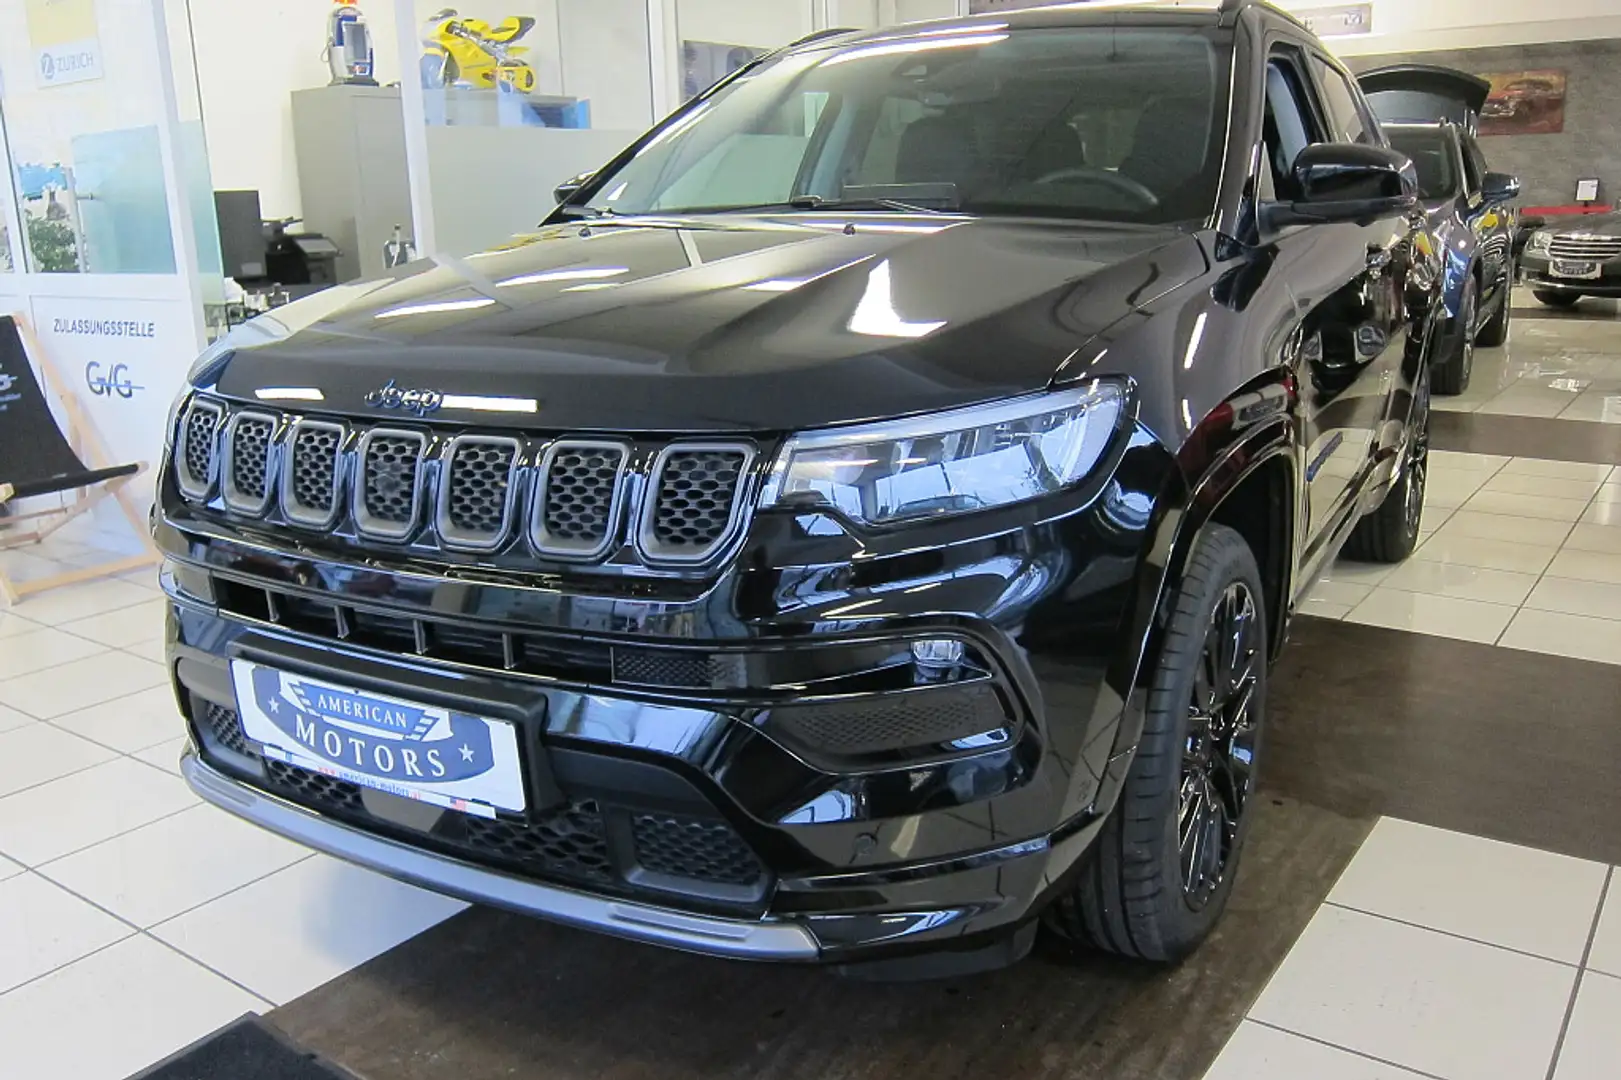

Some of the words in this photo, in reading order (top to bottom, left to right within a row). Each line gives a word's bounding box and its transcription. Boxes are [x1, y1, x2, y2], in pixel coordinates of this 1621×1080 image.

[57, 52, 94, 73] ZURICH
[53, 318, 156, 337] ZULASSUNGSSTELLE
[318, 694, 408, 728] AMERICAN
[296, 715, 446, 778] MOTORS
